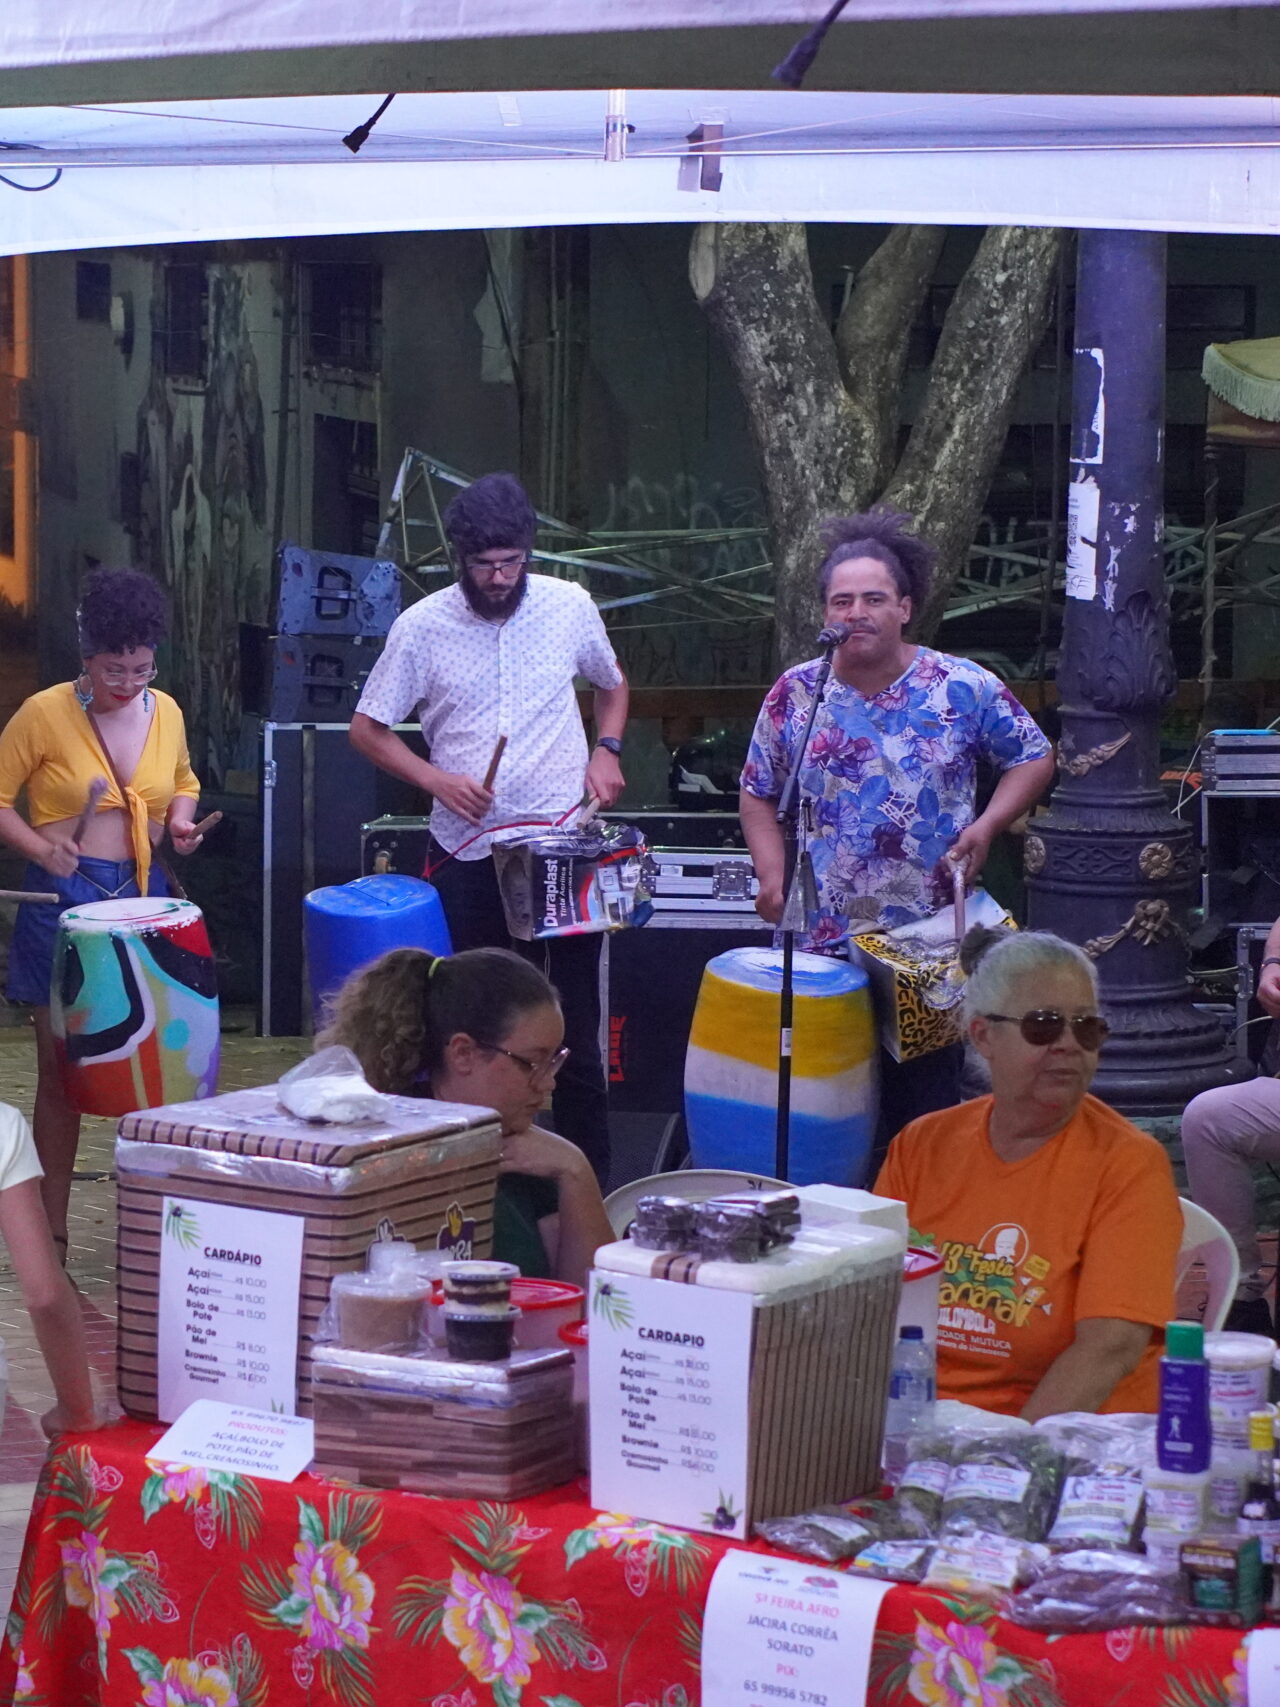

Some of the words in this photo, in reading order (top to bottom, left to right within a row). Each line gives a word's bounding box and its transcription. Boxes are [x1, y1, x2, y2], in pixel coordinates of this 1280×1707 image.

[543, 858, 559, 928] Duraplast
[204, 1247, 262, 1266] CARDÁPIO
[969, 1250, 1016, 1277] Festa
[186, 1299, 205, 1309] Bolo
[208, 1303, 219, 1312] de
[939, 1282, 1017, 1325] anana
[193, 1310, 212, 1321] Pote
[205, 1328, 217, 1336] de
[192, 1335, 207, 1344] Mel
[970, 1335, 1012, 1350] MUTUCA
[185, 1349, 218, 1362] Brownie
[620, 1382, 641, 1393] Bolo
[645, 1386, 657, 1396] de
[628, 1393, 650, 1405] Pote
[628, 1419, 645, 1430] Mel
[643, 1413, 656, 1422] de
[226, 1420, 289, 1436] PRODUTOS:
[270, 1440, 286, 1449] DE
[621, 1434, 659, 1448] Brownie
[258, 1450, 275, 1459] DE
[755, 1593, 768, 1604] 5ª
[769, 1594, 804, 1612] FEIRA
[806, 1603, 840, 1619] AFRO
[747, 1614, 787, 1632] JACIRA
[767, 1638, 815, 1659] SORATO
[776, 1663, 799, 1677] PIX:
[744, 1680, 758, 1692] 65
[799, 1690, 828, 1707] 5782
